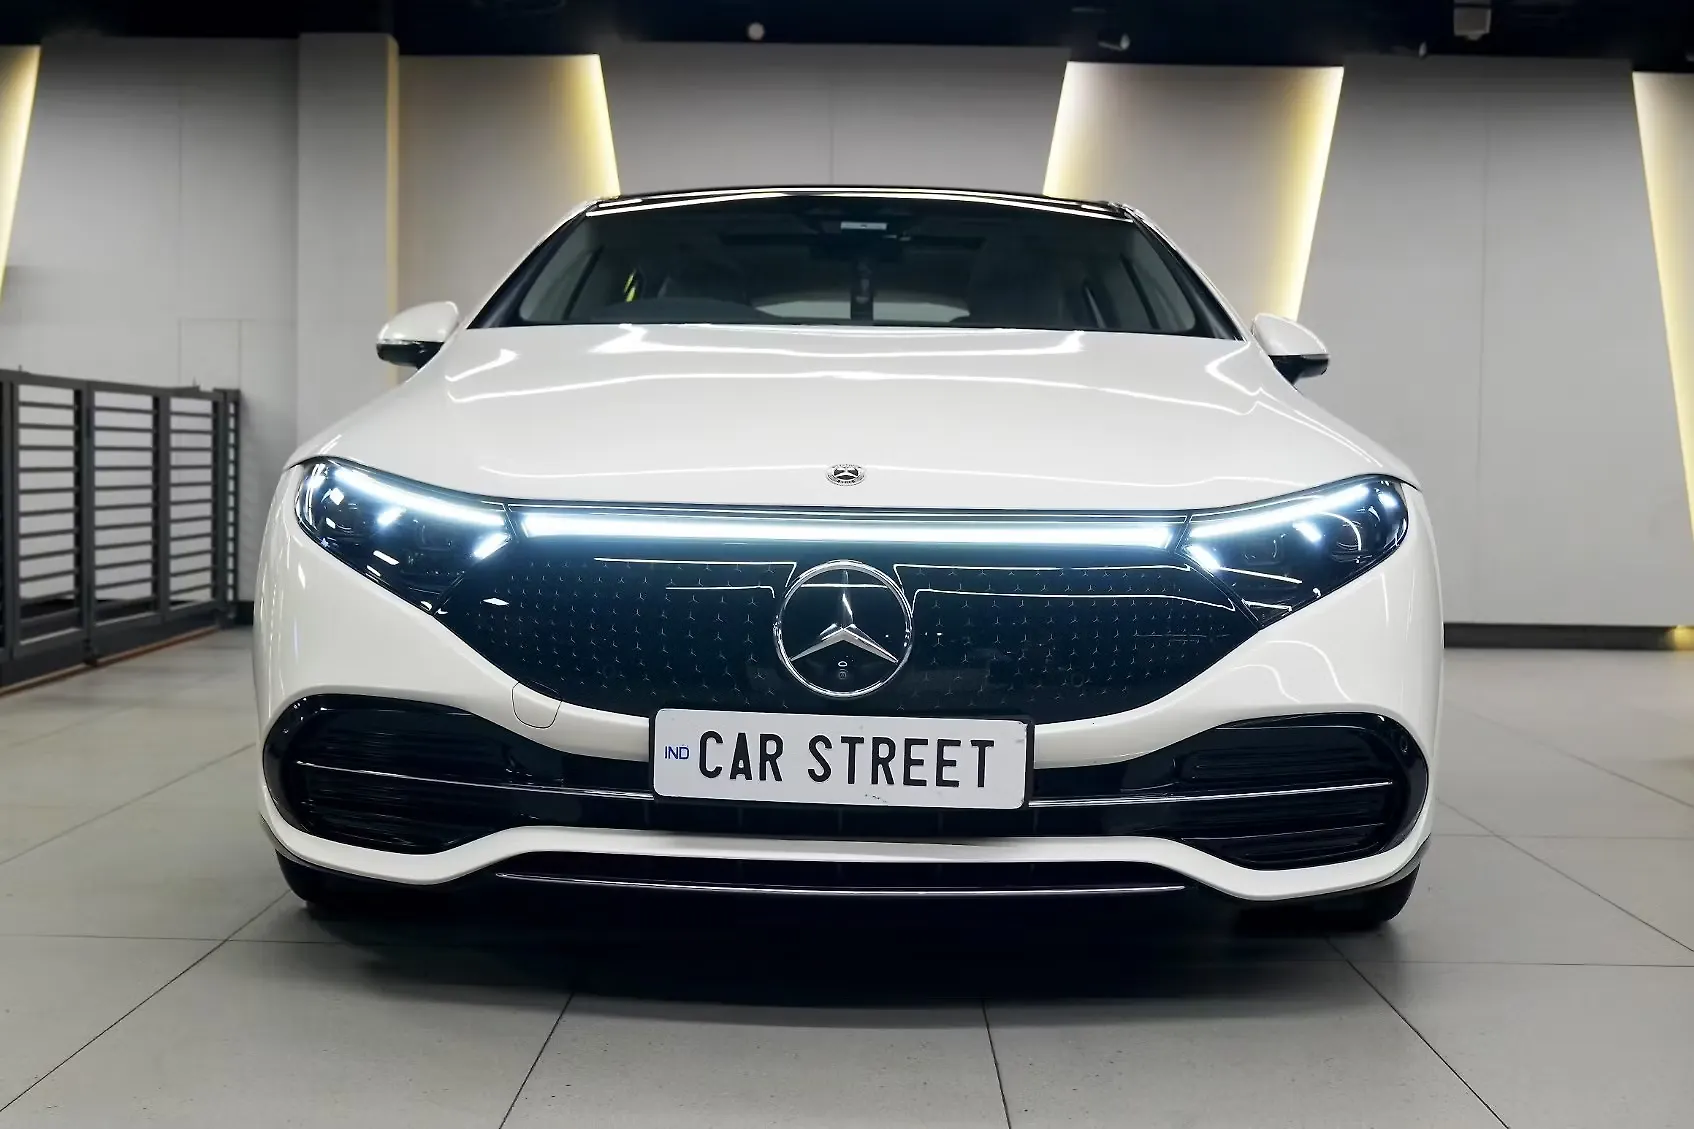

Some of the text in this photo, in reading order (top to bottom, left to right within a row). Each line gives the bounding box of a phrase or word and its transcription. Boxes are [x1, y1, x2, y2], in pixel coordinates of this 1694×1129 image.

[664, 745, 690, 760] IND
[699, 730, 995, 788] CAR STREET
